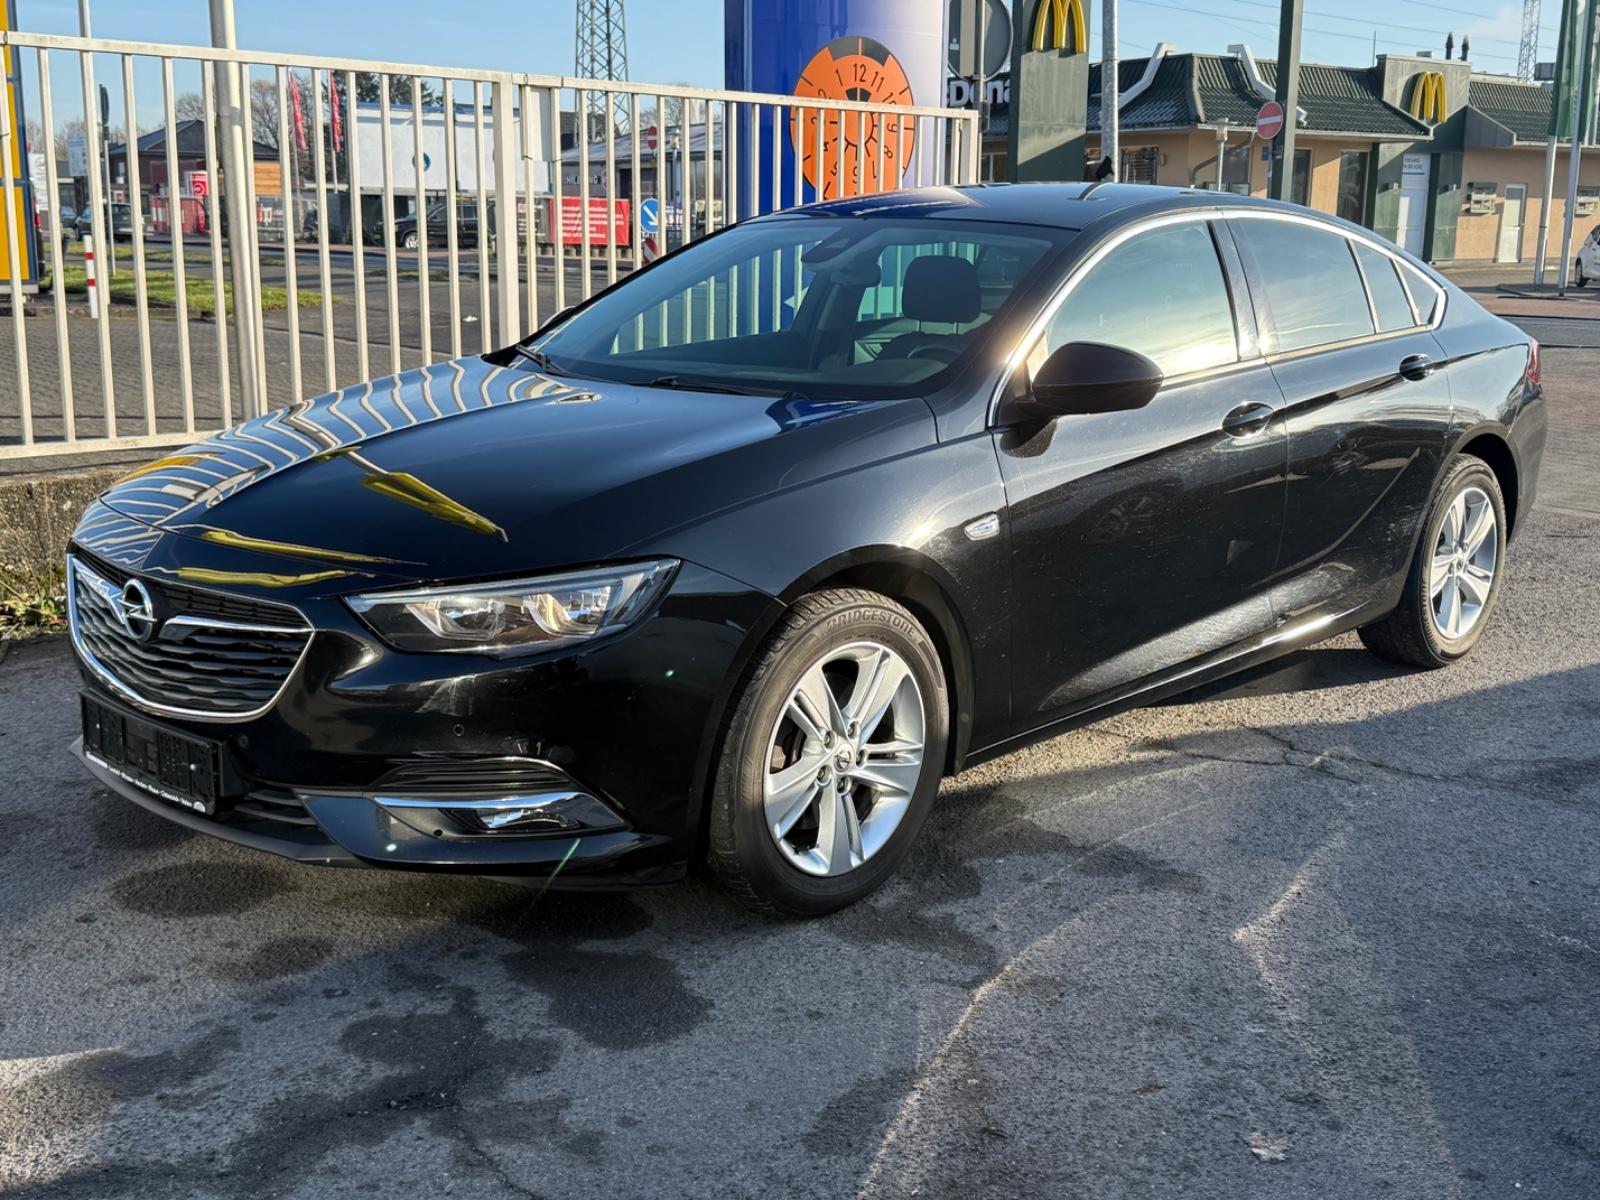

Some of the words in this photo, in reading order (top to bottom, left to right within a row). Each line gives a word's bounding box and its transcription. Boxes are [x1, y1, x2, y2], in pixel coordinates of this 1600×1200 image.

[835, 69, 843, 87] 1
[853, 64, 866, 82] 12
[870, 71, 885, 92] 11
[826, 609, 915, 638] BRIDGESTONE
